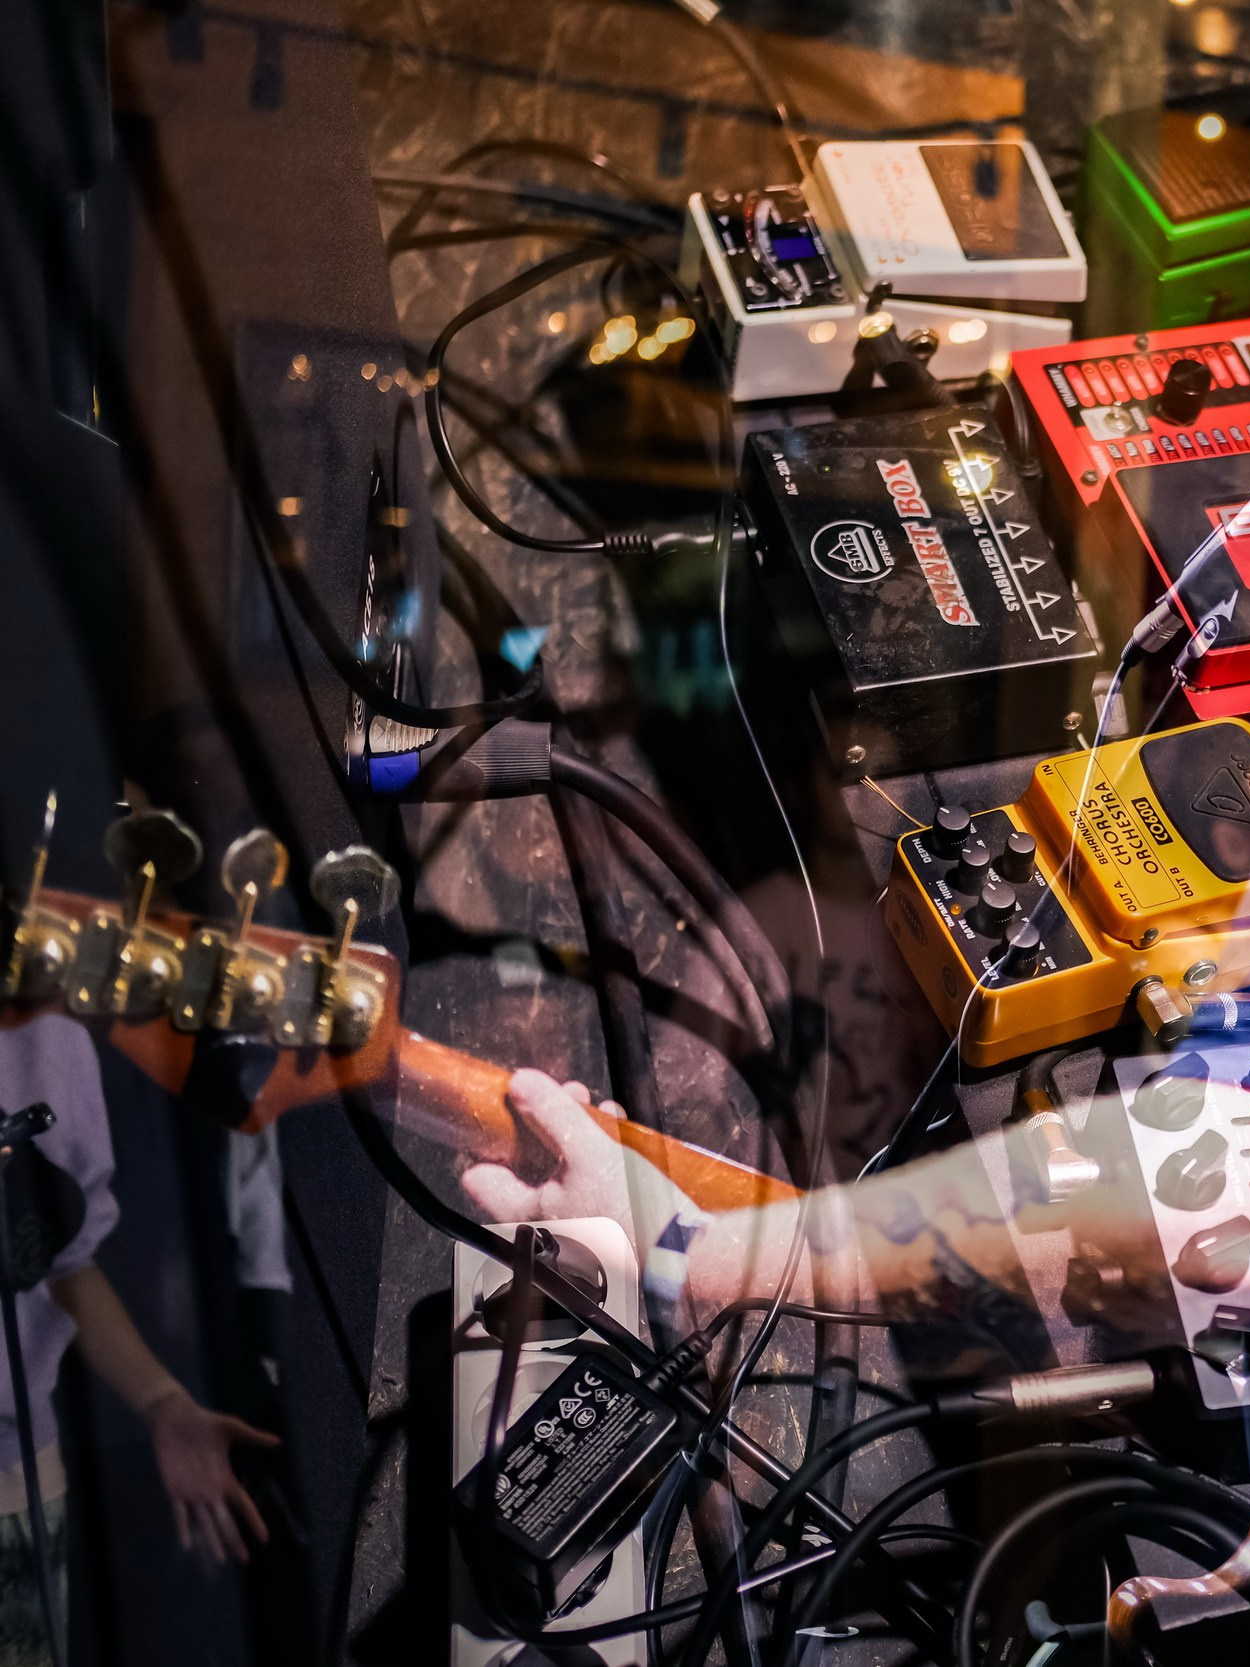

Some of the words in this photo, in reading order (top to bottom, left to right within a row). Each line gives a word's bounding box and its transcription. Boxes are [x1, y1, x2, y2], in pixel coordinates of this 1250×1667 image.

[771, 451, 782, 461] V
[774, 459, 791, 478] 220
[783, 481, 799, 498] AC
[877, 459, 931, 518] BOX
[962, 500, 983, 526] OUT
[973, 528, 988, 537] 7
[839, 532, 865, 573] SMB
[872, 529, 893, 568] EFFECTS
[978, 538, 1021, 612] STABILIZED
[1041, 764, 1054, 776] IN
[1083, 799, 1131, 866] CHORUS
[1094, 781, 1159, 874] ORCHESTRA
[1133, 798, 1171, 844] CO600
[1069, 810, 1107, 865] BEHRINGER
[912, 838, 932, 864] DEPTH
[935, 880, 953, 900] HIGH
[1175, 877, 1193, 897] OUT
[934, 898, 955, 928] ON/BATT
[1119, 891, 1137, 912] OUT
[958, 919, 976, 940] RATE
